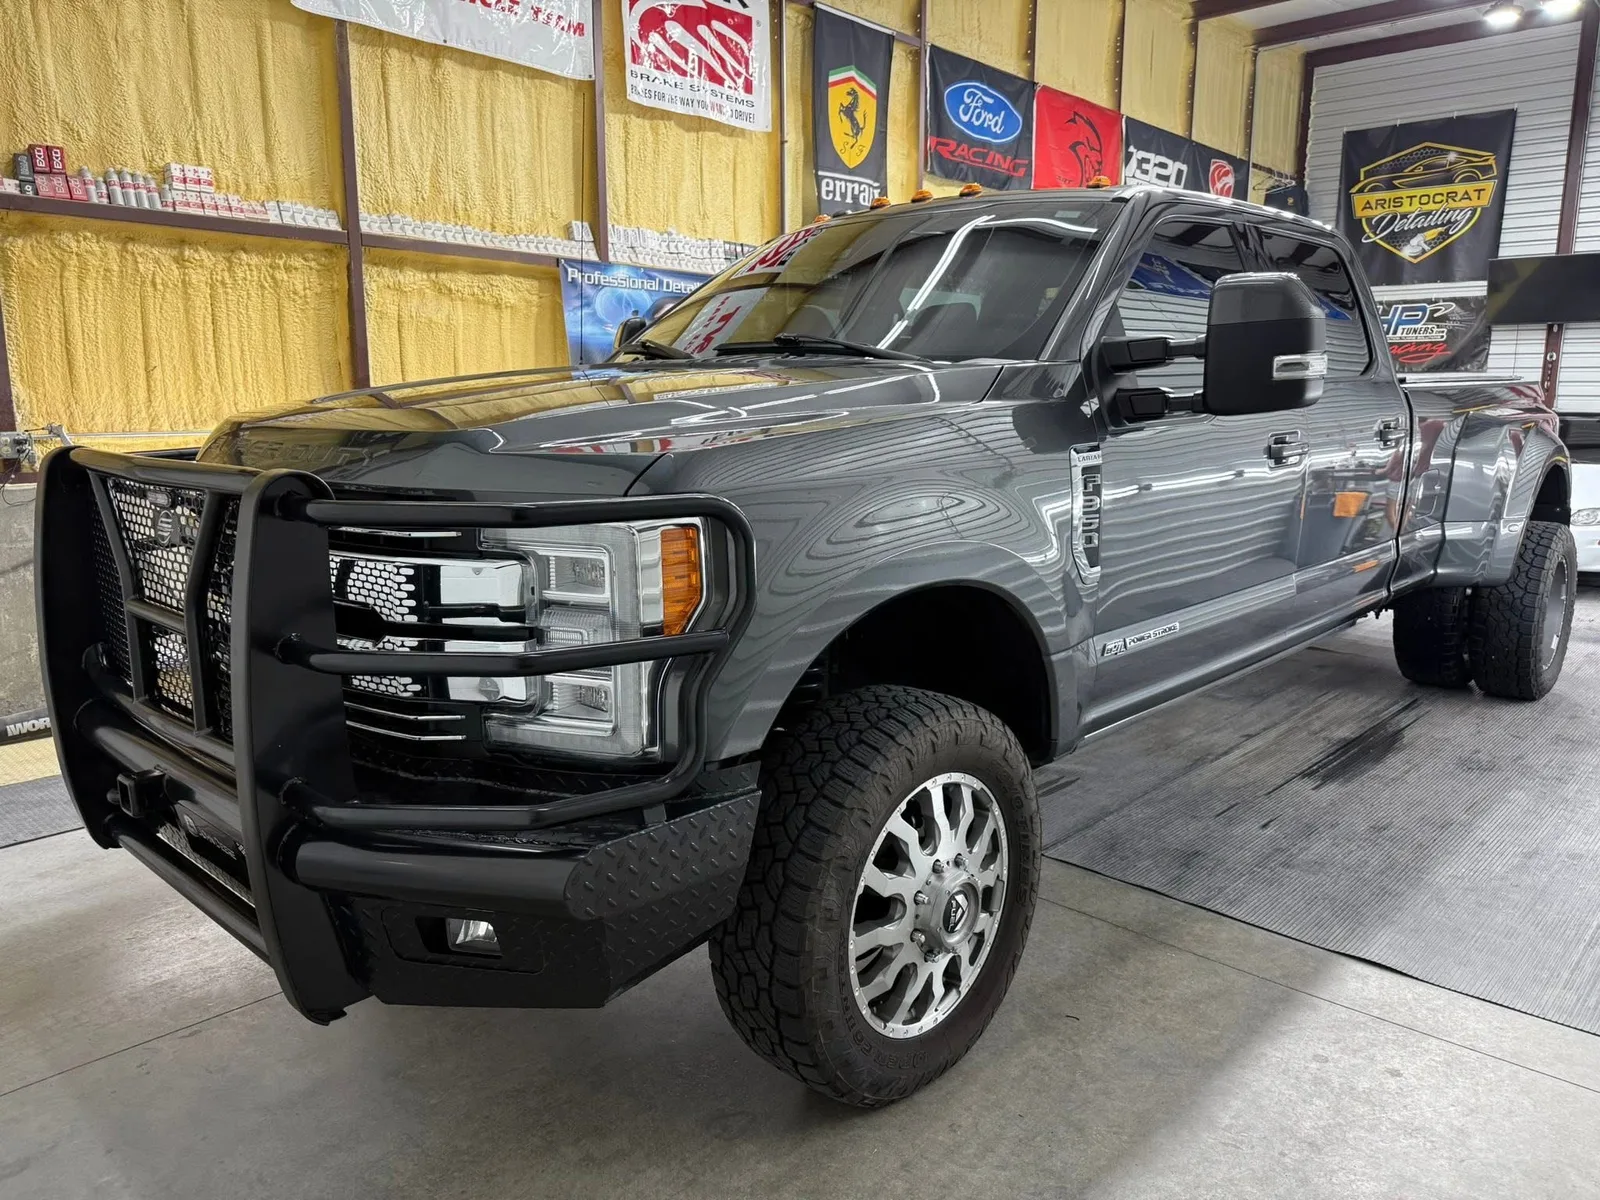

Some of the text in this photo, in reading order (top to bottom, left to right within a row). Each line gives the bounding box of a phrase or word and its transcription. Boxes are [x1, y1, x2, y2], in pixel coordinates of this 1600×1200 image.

[630, 69, 755, 108] BRAKE SYSTEMS
[653, 90, 666, 102] FOR
[679, 97, 694, 108] WAY
[959, 88, 1005, 134] Ford
[929, 136, 1029, 177] RACING
[1361, 188, 1487, 212] ARISTOCRAT
[1361, 202, 1473, 244] Detailing
[567, 267, 659, 291] Professional
[1401, 326, 1435, 336] TUNERS
